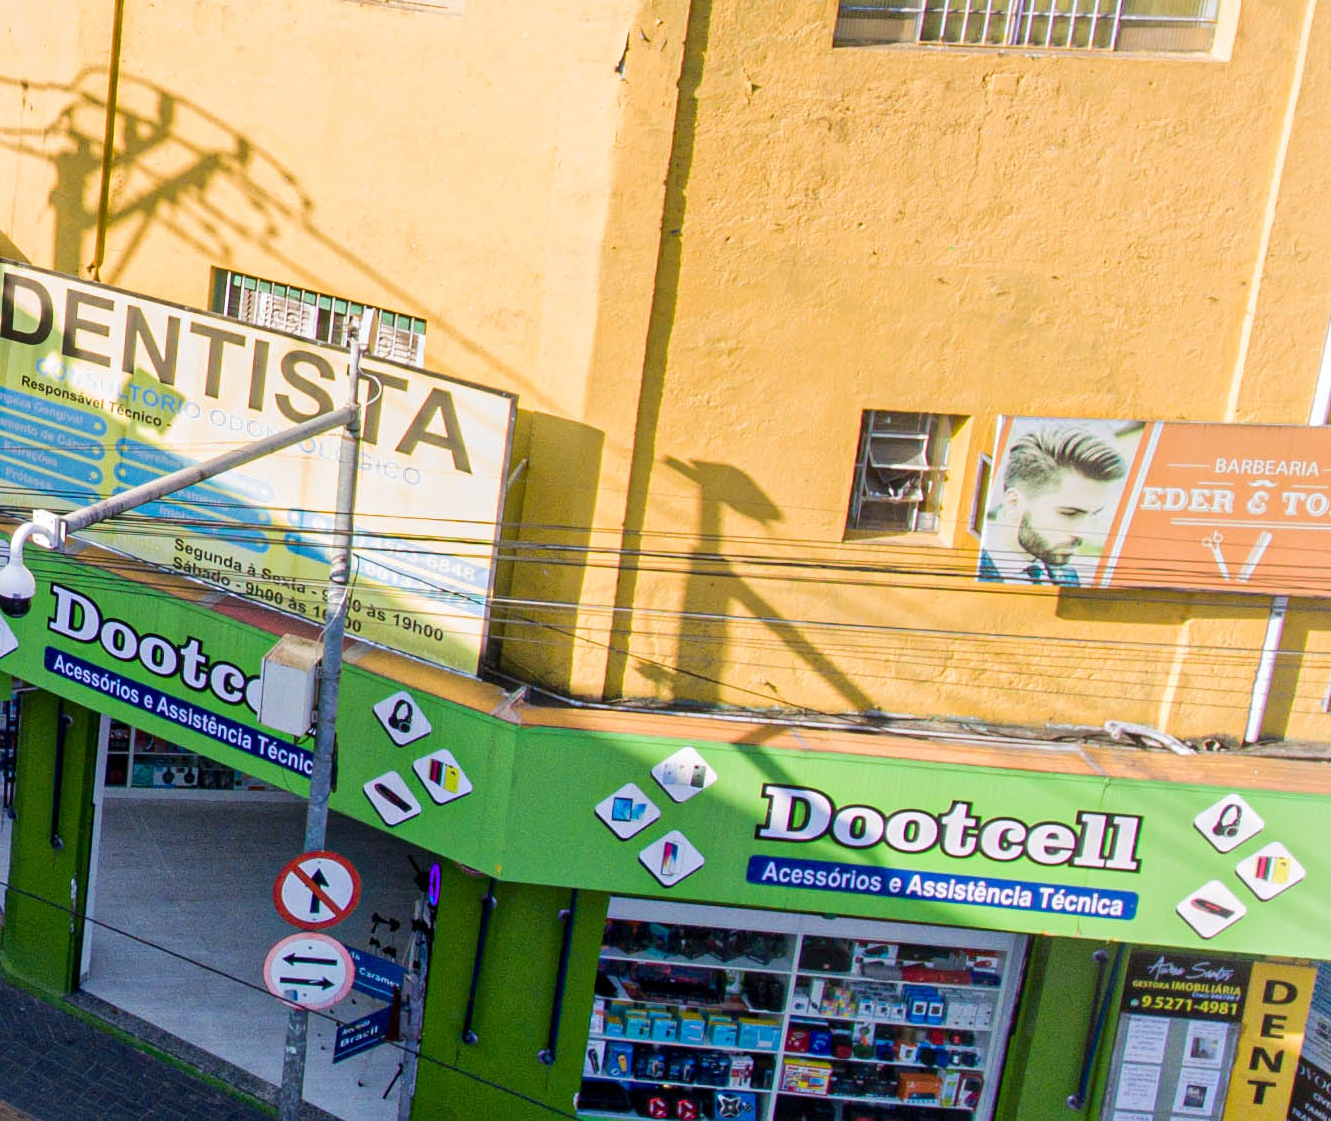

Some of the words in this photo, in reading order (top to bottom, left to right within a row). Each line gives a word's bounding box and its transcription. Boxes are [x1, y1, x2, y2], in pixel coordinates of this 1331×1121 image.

[0, 272, 473, 475] DENTISTA
[21, 375, 105, 410] Responsável
[110, 399, 162, 427] Técnico
[1214, 457, 1320, 477] BARBEARIA
[1140, 486, 1235, 514] EDER
[1246, 489, 1270, 515] &
[172, 556, 231, 587] Sábado
[245, 581, 284, 605] 9h00
[288, 595, 307, 614] às
[173, 538, 242, 572] Segunda
[366, 601, 386, 622] às
[392, 613, 443, 641] 19h00
[47, 582, 264, 716] Dootc
[53, 654, 140, 703] Acessórios
[143, 695, 154, 709] e
[156, 696, 252, 750] Assistência
[257, 734, 314, 775] Técnic
[754, 782, 1145, 874] Dootcell
[761, 860, 882, 892] Acessórios
[888, 877, 903, 894] e
[906, 875, 1033, 907] Assistência
[1039, 886, 1124, 917] Técnica
[1171, 980, 1242, 996] IMOBILIÁRIA
